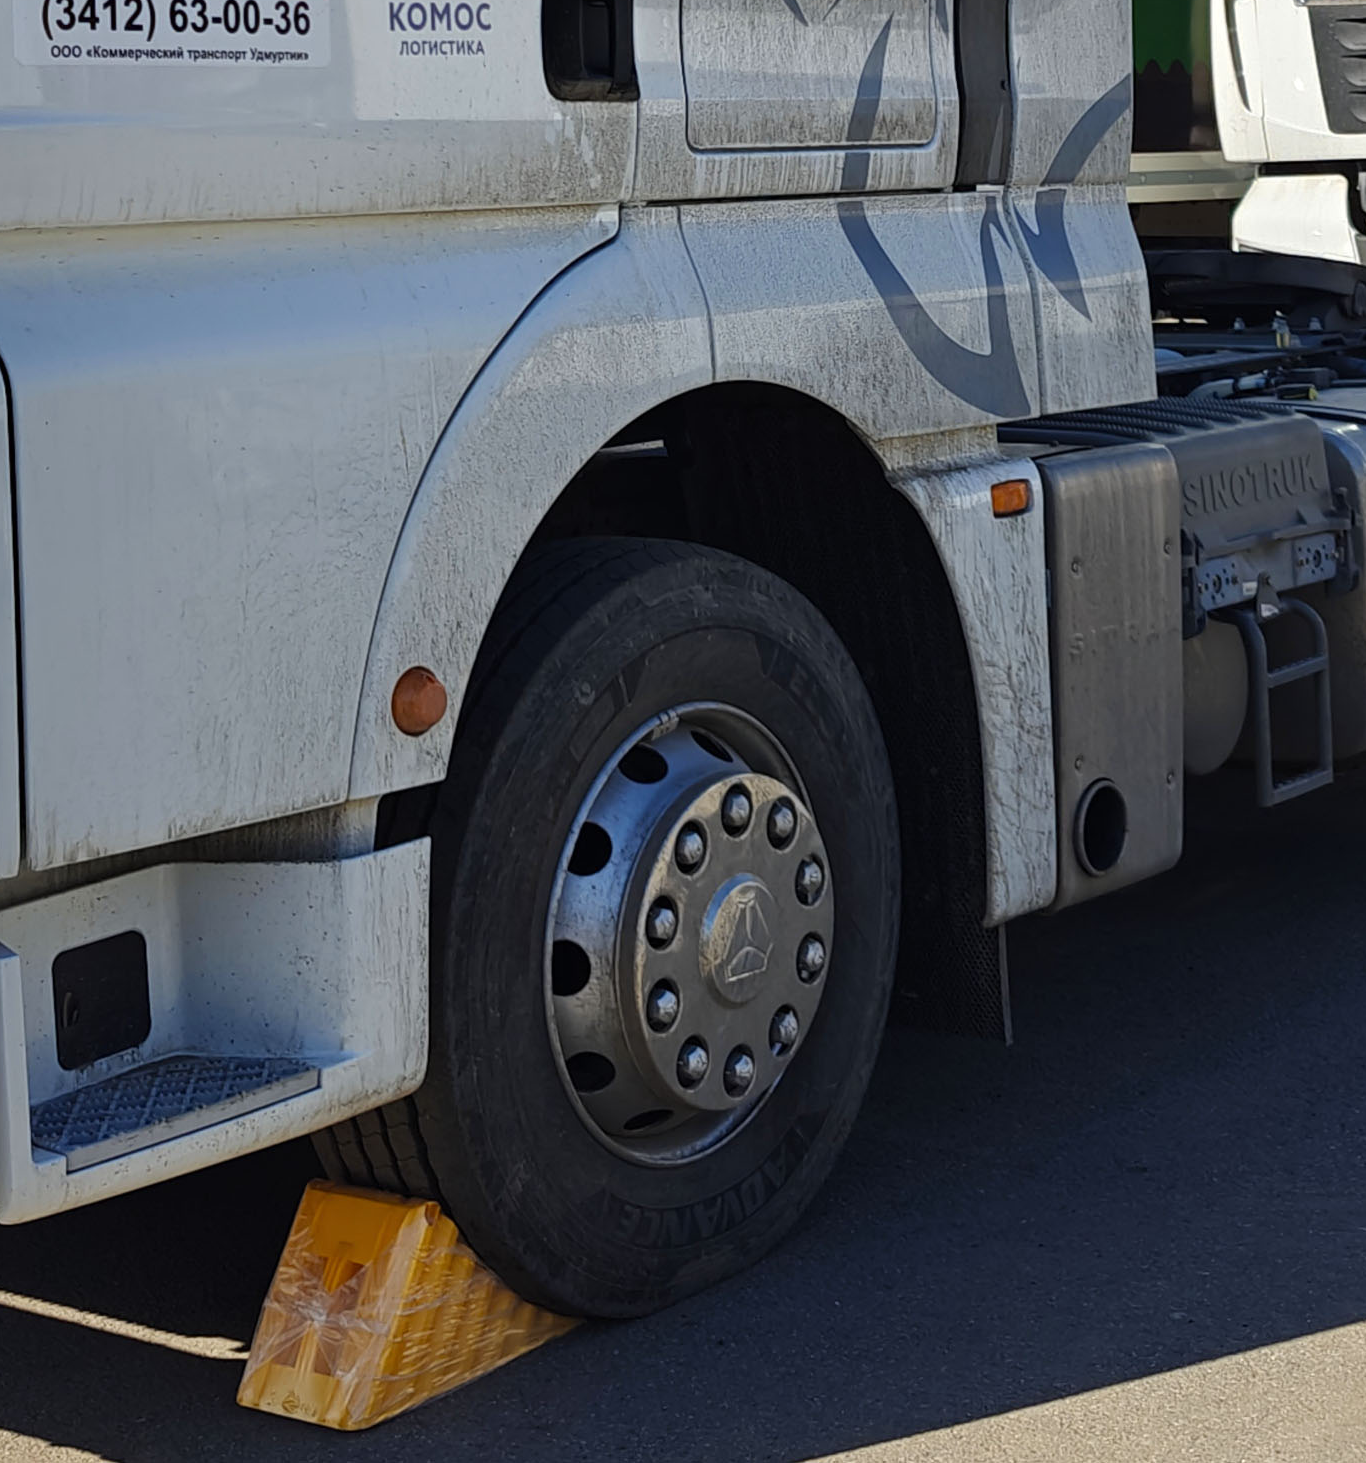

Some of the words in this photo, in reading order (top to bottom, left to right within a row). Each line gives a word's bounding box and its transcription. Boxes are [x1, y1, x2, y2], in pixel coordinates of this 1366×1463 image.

[388, 1, 492, 31] КОМОС
[50, 44, 82, 59] ООО
[85, 44, 184, 62] «Коммерческий
[187, 49, 246, 63] транспорт
[399, 40, 485, 56] ЛОГИСТИКА
[1182, 451, 1320, 518] SINOTRUK
